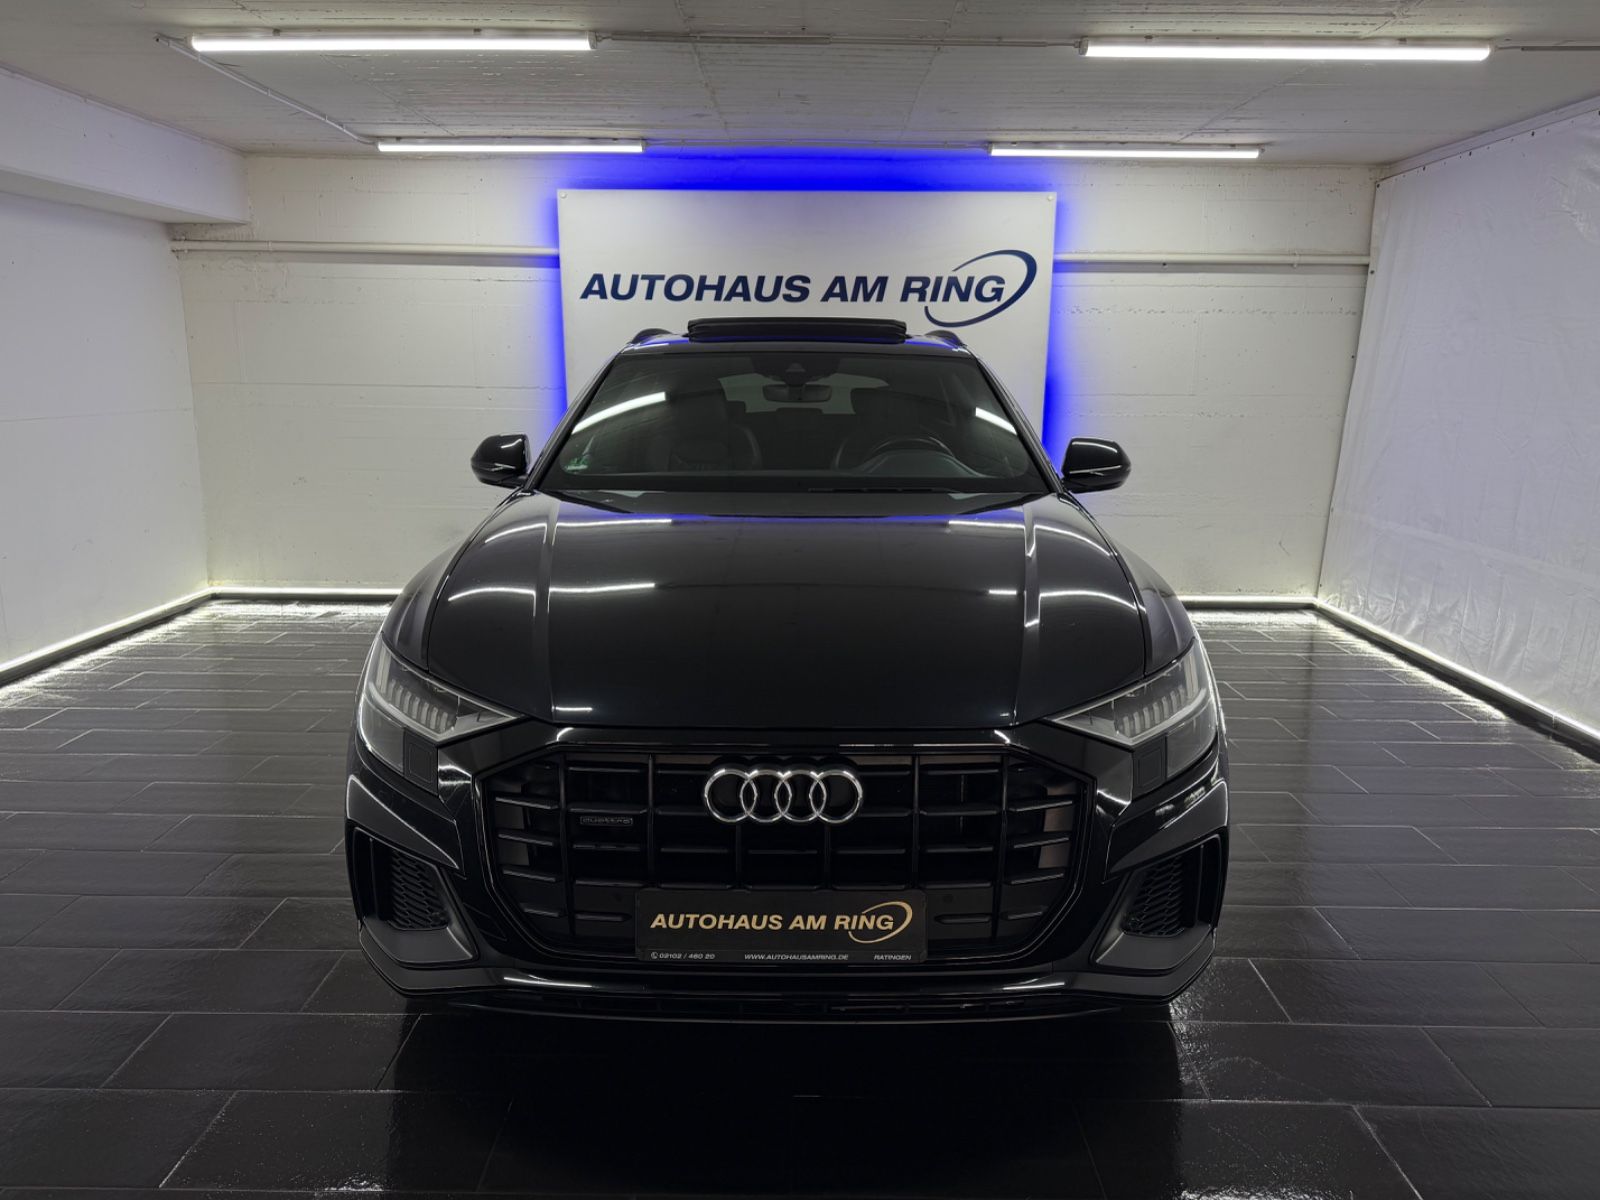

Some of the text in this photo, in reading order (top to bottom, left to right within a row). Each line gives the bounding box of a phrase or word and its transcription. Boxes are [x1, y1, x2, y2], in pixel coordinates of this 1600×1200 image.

[579, 272, 1006, 304] AUTOHAUS AM RING
[650, 913, 894, 932] AUTOHAUS AM RING
[744, 953, 849, 961] WWW.AUTOHAUSAMRING.DE
[874, 953, 912, 961] RATINGEN
